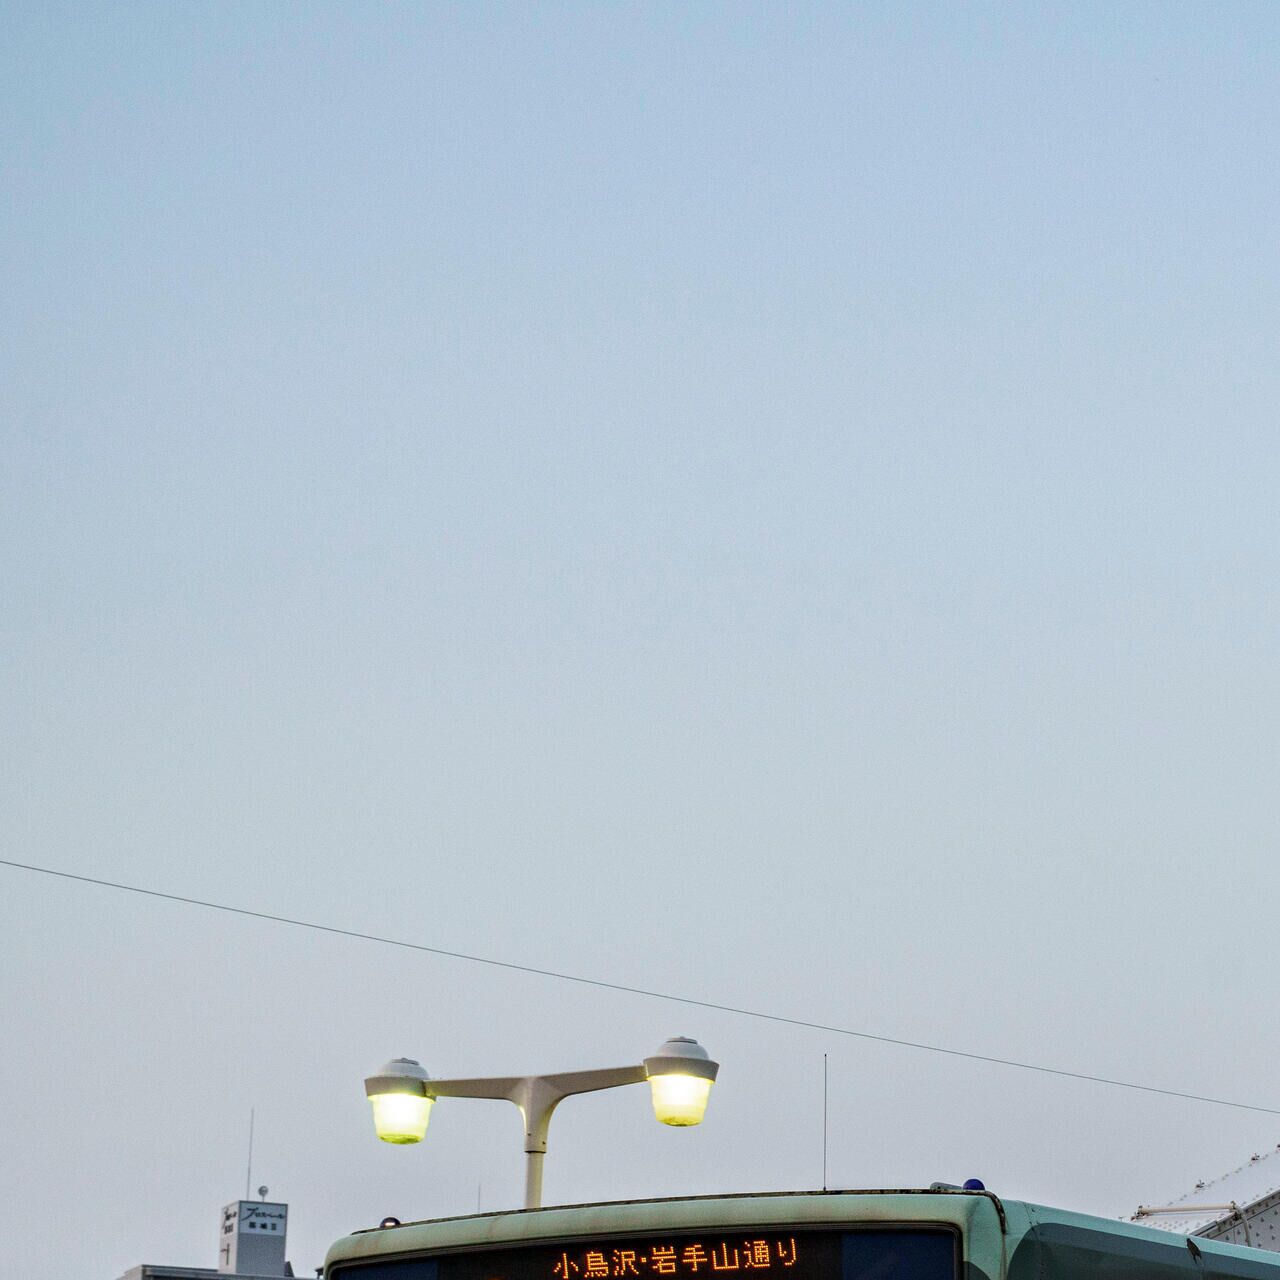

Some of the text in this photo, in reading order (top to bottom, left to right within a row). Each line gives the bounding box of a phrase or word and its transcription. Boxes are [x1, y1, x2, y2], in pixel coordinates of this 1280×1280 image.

[554, 1239, 797, 1279] 小鳥沢・岩手山通り
